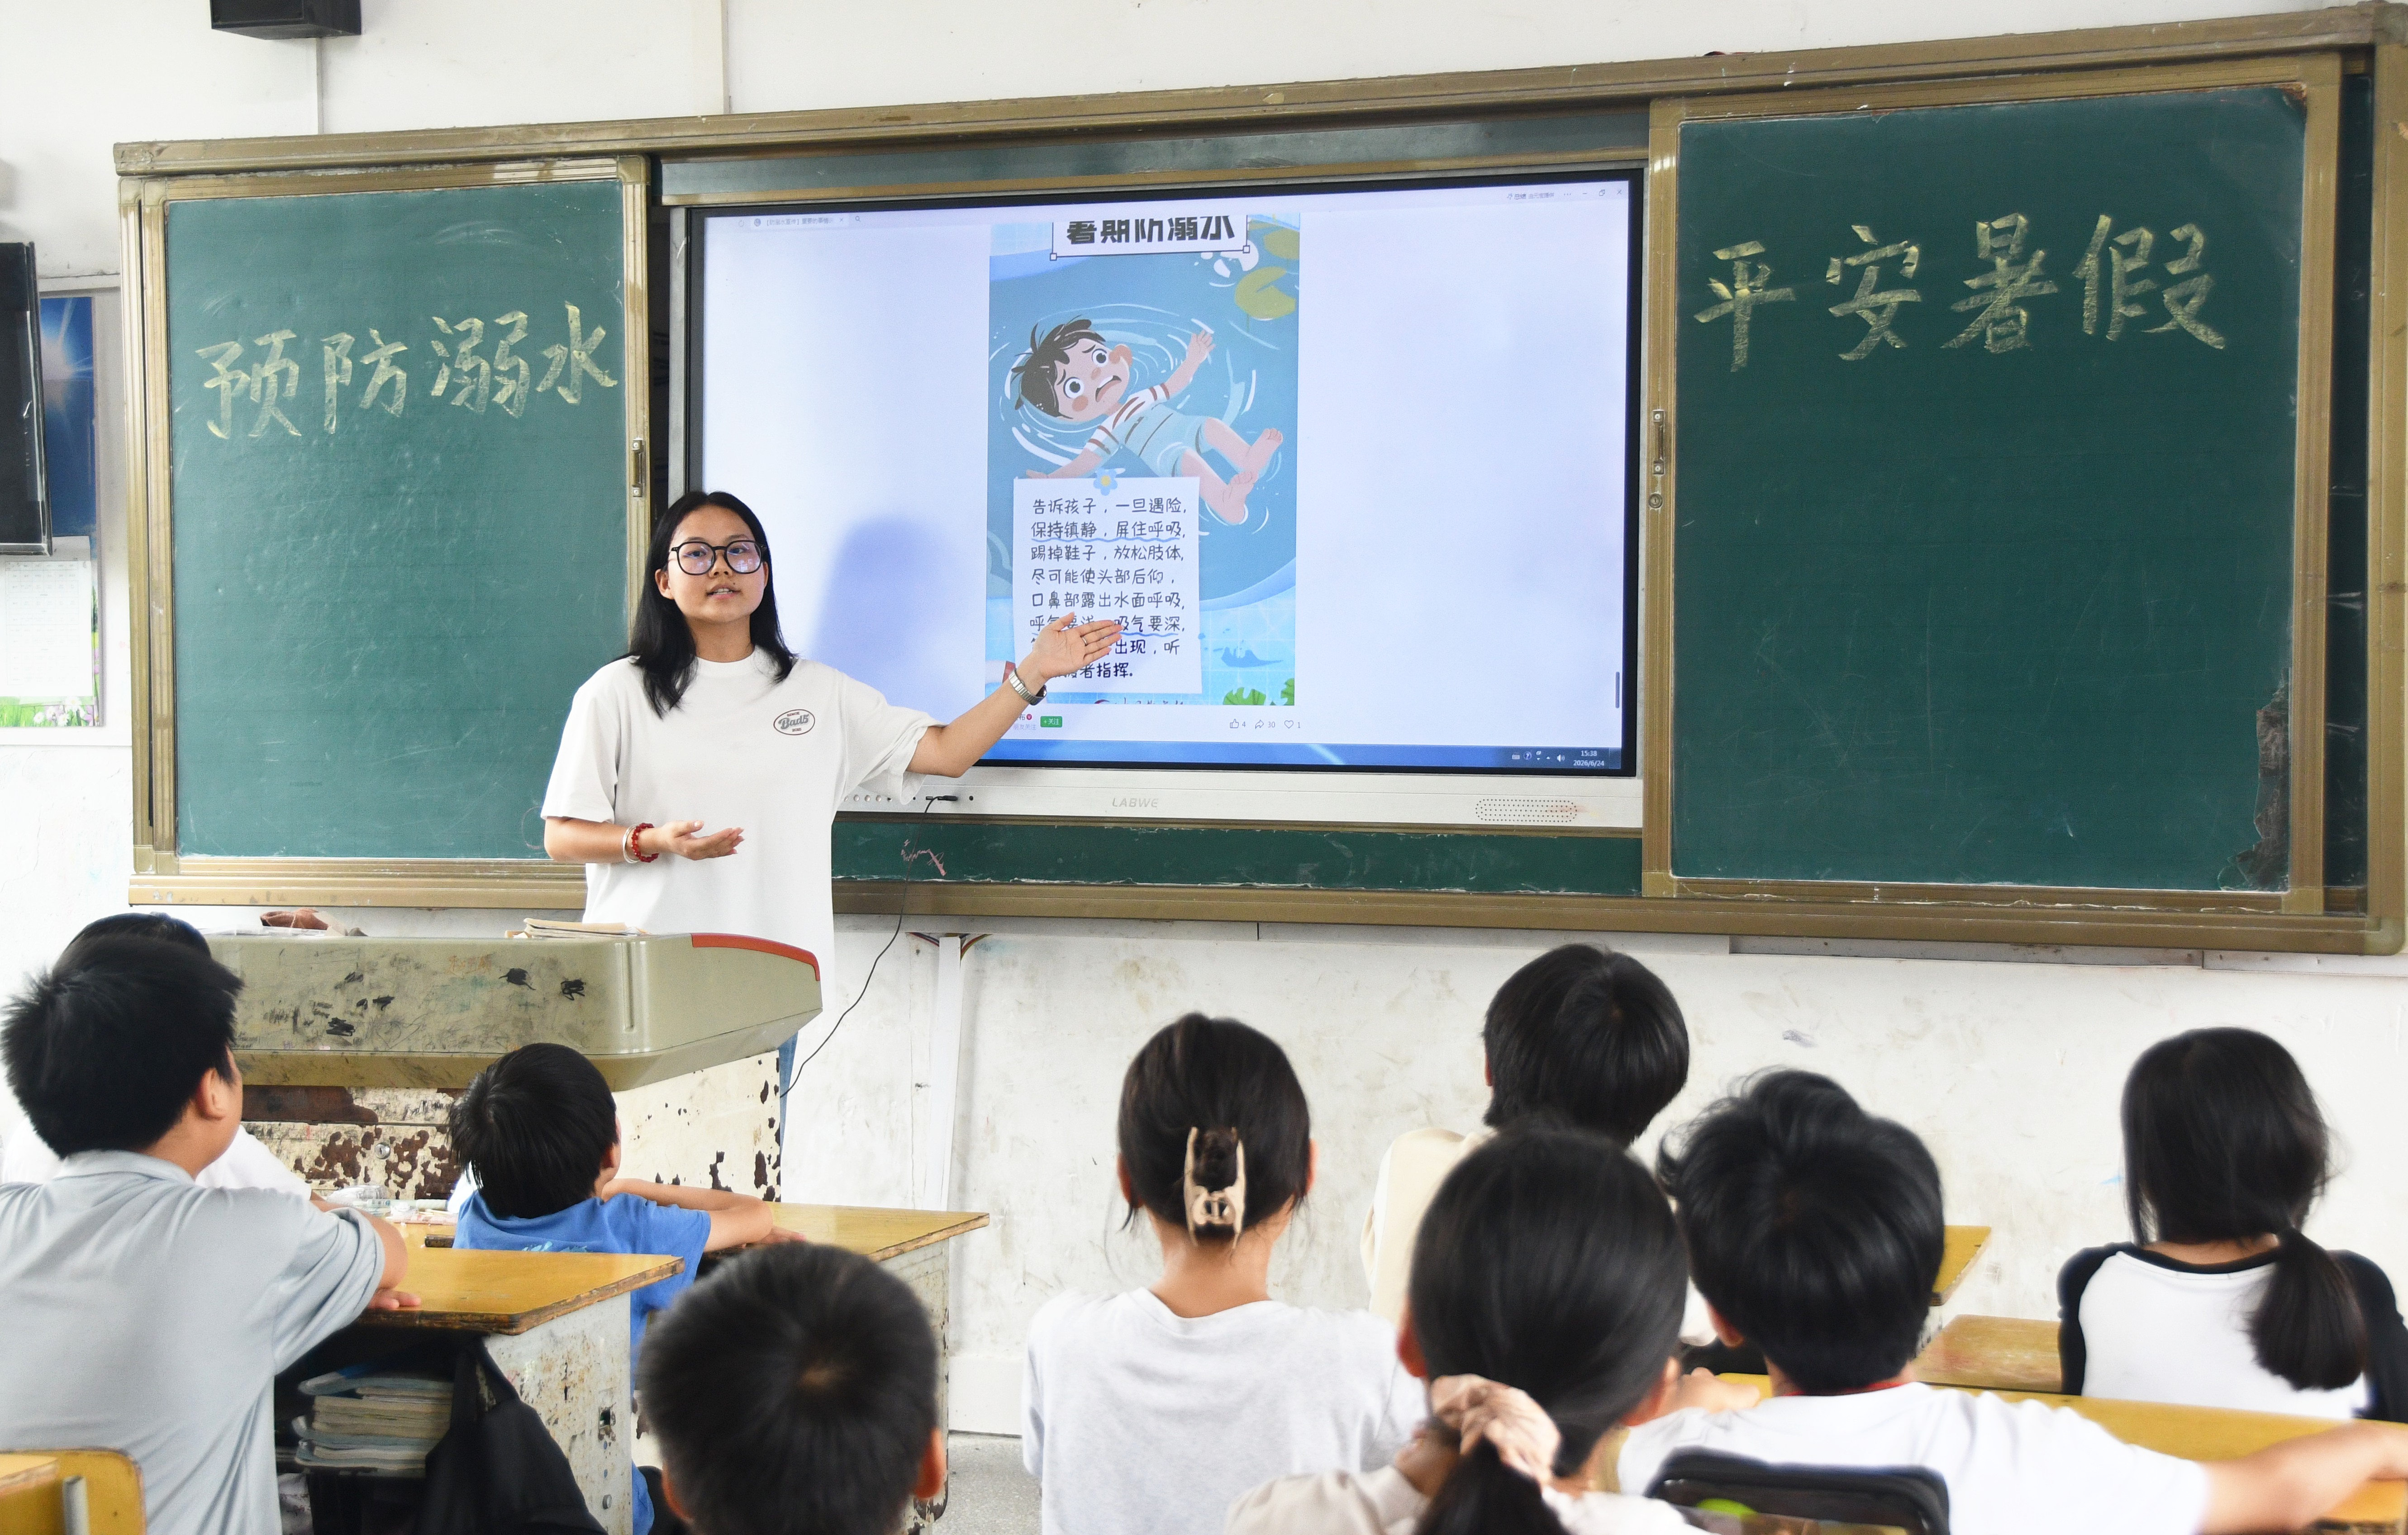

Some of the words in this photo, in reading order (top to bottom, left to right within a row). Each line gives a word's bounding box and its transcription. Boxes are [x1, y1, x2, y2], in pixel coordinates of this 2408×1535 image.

[1694, 212, 2225, 372] 平安暑假
[195, 301, 618, 439] 预防溺水
